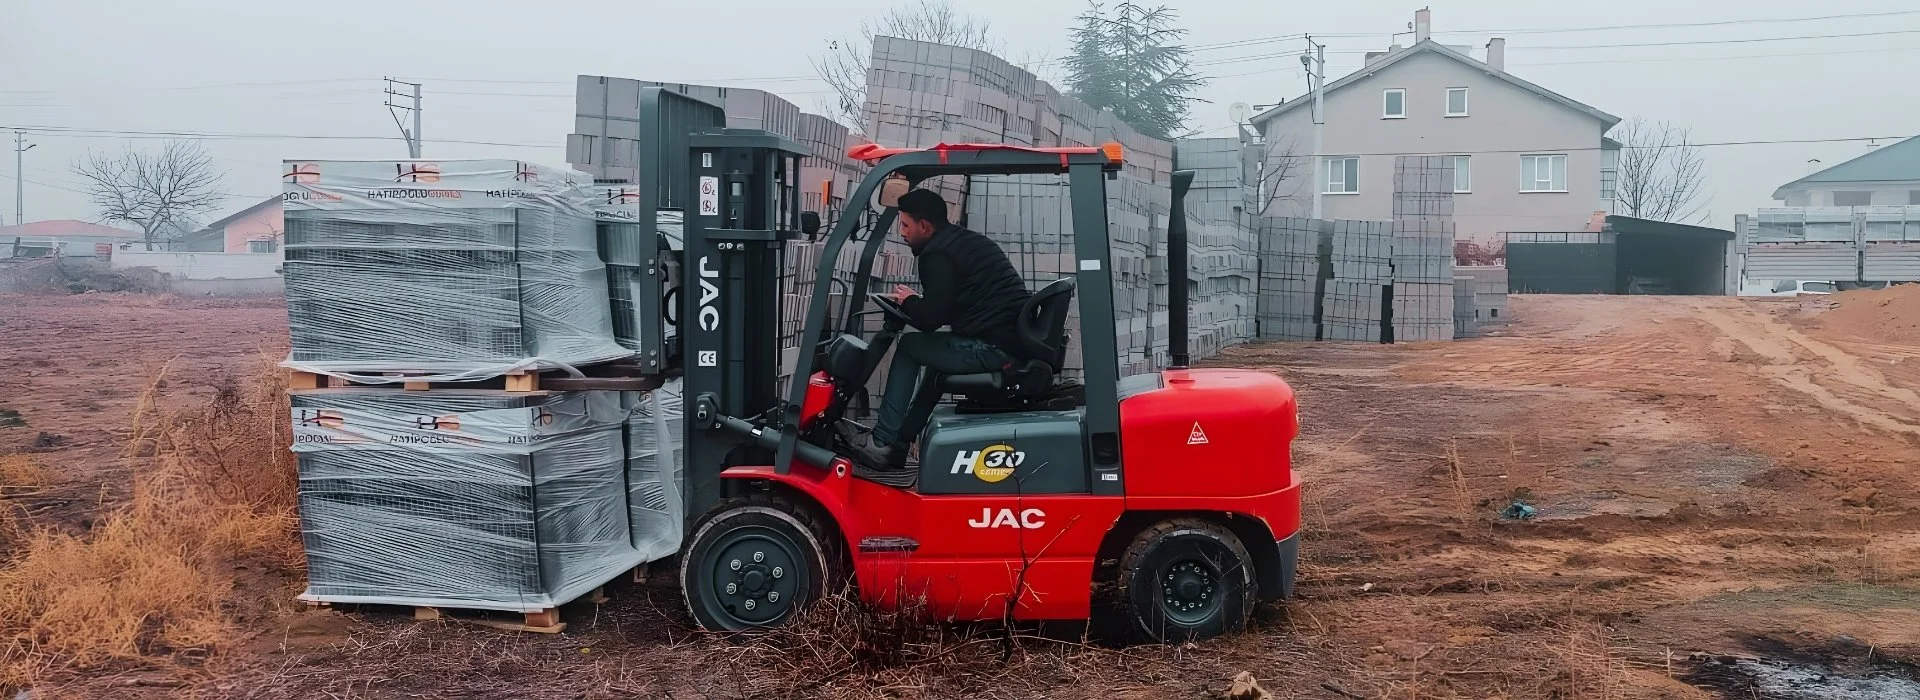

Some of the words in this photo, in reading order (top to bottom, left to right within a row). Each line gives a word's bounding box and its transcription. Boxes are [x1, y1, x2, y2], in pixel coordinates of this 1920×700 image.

[699, 255, 720, 332] JAC
[700, 353, 715, 364] CE
[968, 507, 1046, 529] JAC
